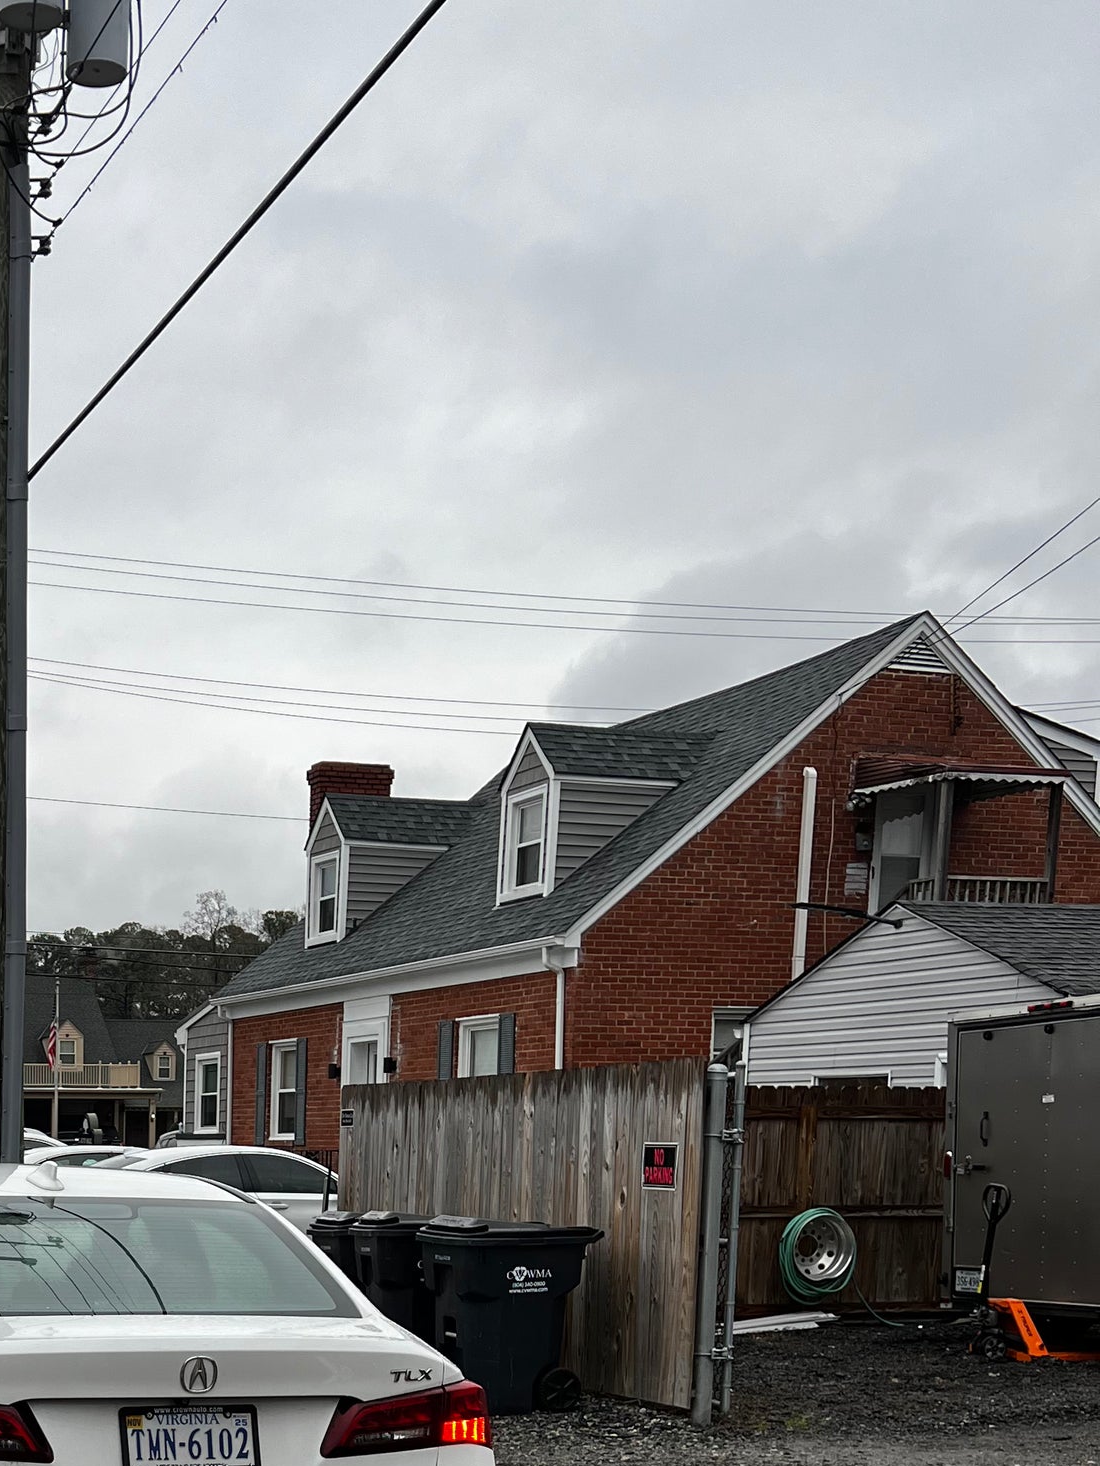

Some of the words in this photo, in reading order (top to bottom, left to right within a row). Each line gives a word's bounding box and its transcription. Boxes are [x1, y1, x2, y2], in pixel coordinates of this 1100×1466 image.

[654, 1148, 665, 1166] NO
[645, 1167, 672, 1184] PARKING
[390, 1368, 433, 1383] TLX
[153, 1406, 224, 1414] www.crownauto.com
[127, 1418, 142, 1427] NOV
[156, 1413, 220, 1425] VIRGINIA
[234, 1418, 248, 1427] 25
[130, 1427, 250, 1461] TMN-6102
